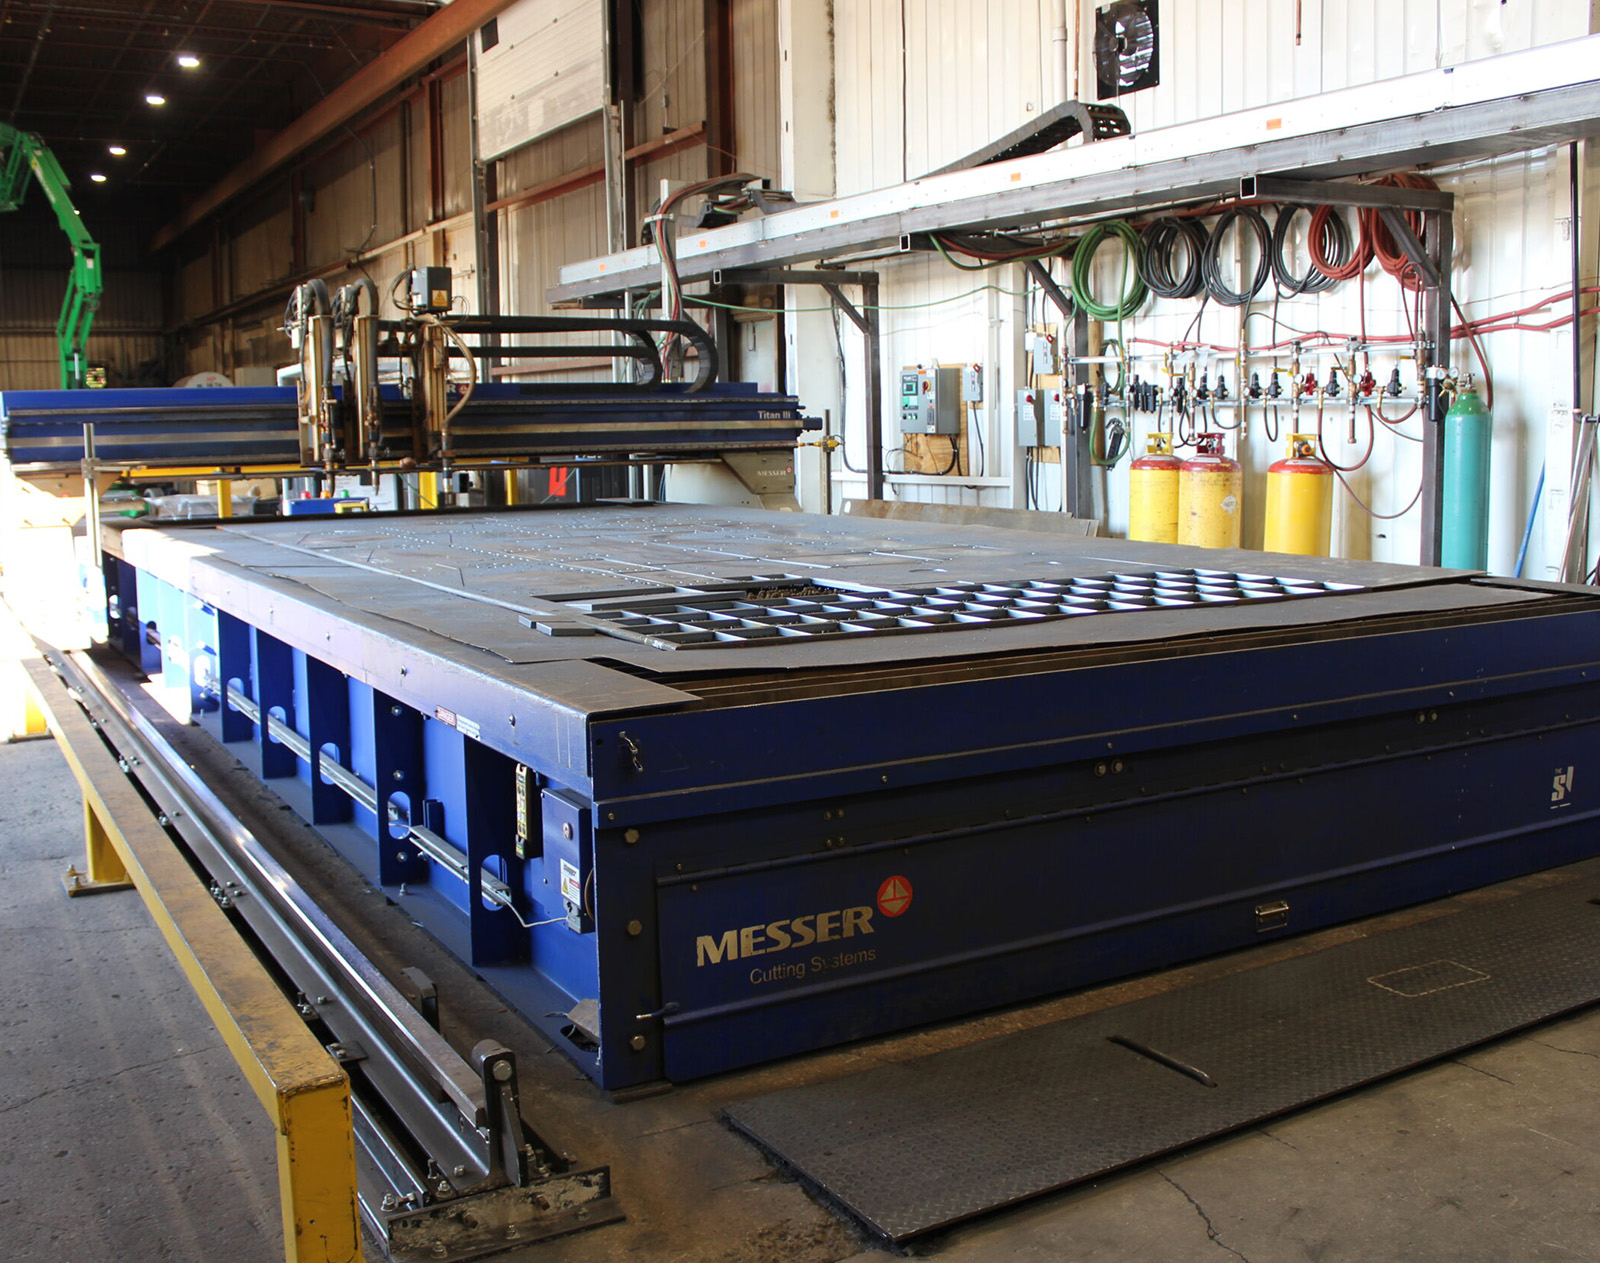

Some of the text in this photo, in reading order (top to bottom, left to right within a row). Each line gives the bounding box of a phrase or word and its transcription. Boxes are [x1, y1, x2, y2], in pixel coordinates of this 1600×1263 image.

[757, 410, 791, 419] Titan III
[696, 905, 875, 967] MESSER
[749, 962, 806, 985] Cutting
